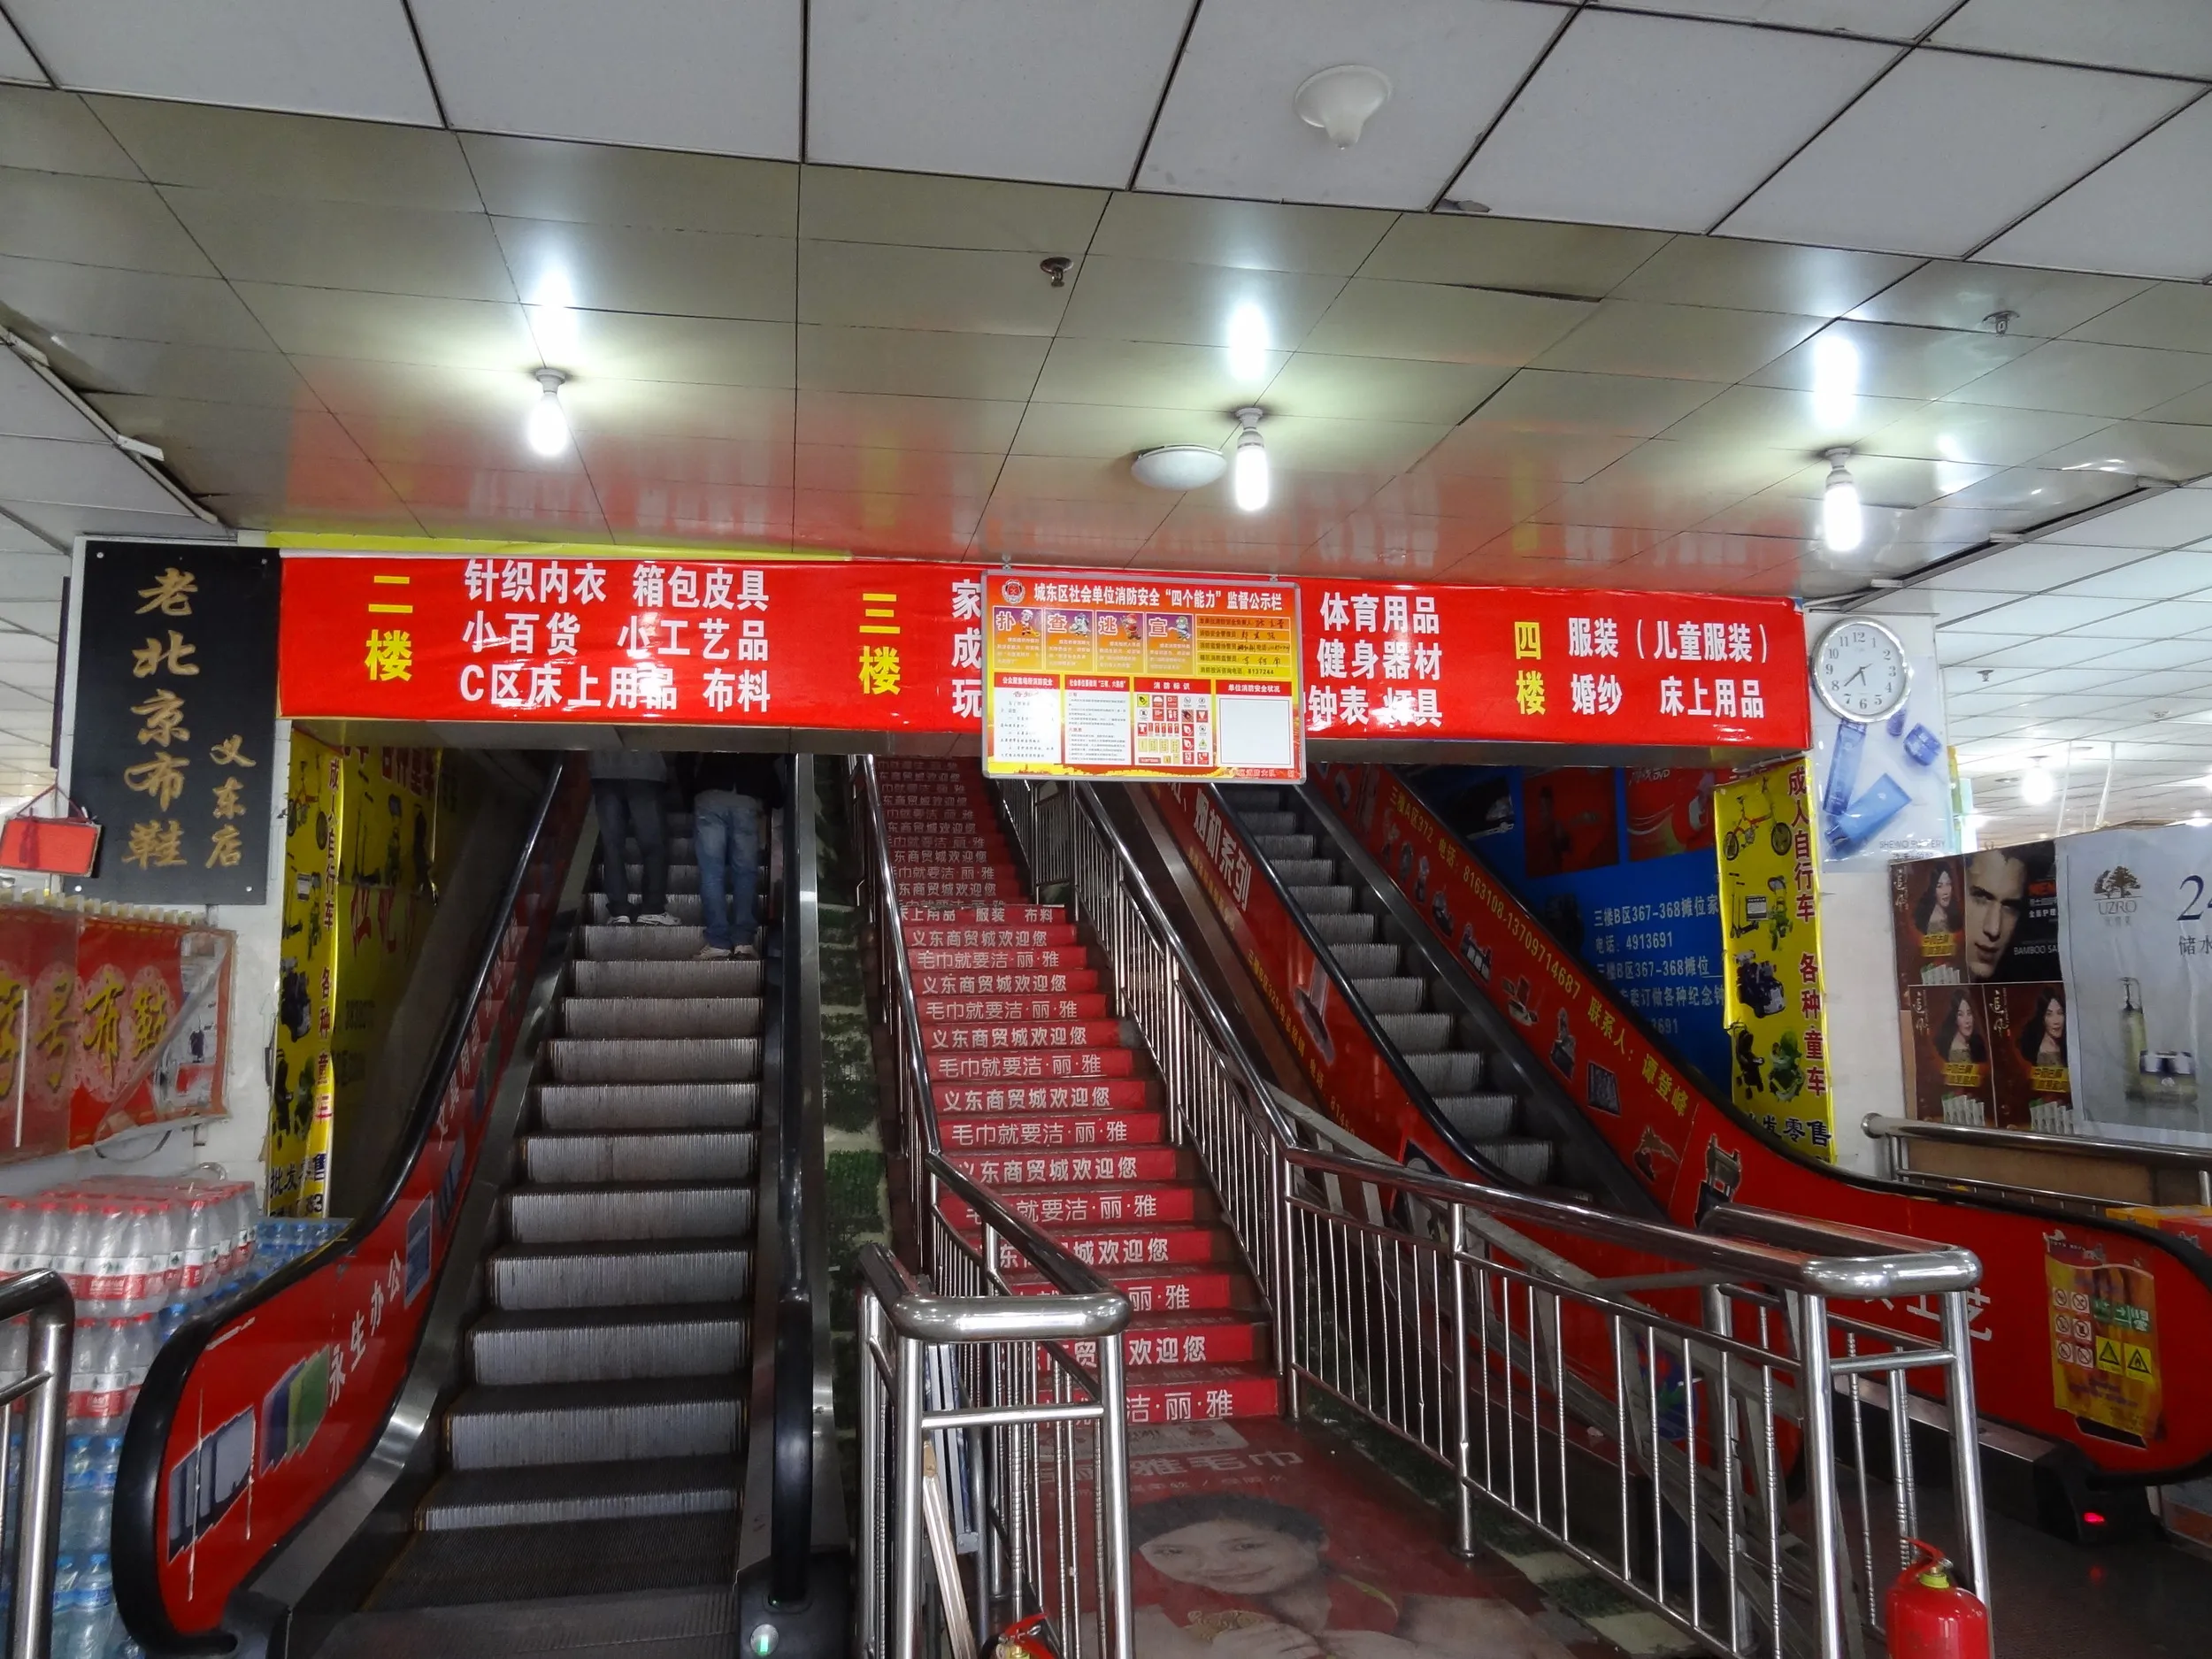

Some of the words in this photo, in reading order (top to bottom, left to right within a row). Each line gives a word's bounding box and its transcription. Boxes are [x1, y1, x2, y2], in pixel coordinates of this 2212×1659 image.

[465, 559, 607, 605] 针织内衣
[633, 564, 770, 611] 箱包皮具
[996, 611, 1017, 632] 扑
[1047, 612, 1067, 634] 查
[1319, 591, 1440, 634] 体育用品
[365, 575, 413, 682] 二楼
[1097, 615, 1118, 636] 逃
[1148, 617, 1169, 637] 宣
[462, 611, 580, 656] 小百货
[617, 615, 768, 662] 小工艺品
[859, 593, 901, 695] 三楼
[1839, 636, 1849, 647] 11
[1852, 632, 1866, 643] 12
[1871, 637, 1877, 648] 1
[1317, 637, 1442, 681] 健身器材
[1828, 648, 1839, 659] 10
[1883, 649, 1891, 660] 2
[1514, 621, 1546, 716] 四楼
[1825, 664, 1833, 675] 9
[1888, 665, 1897, 677] 3
[460, 664, 677, 710] C区床上用品
[703, 668, 771, 713] 布料
[1571, 672, 1624, 716] 婚纱
[1660, 675, 1764, 718] 床上用品
[1831, 680, 1840, 691] 8
[1885, 681, 1893, 693] 4
[1843, 693, 1852, 705] 7
[1859, 698, 1868, 710] 6
[1874, 695, 1883, 706] 5
[121, 567, 200, 868] 老北京布鞋
[205, 733, 257, 868] 义东店
[1787, 765, 1816, 923] 成人自行车
[2098, 900, 2137, 915] UZRO
[2177, 875, 2212, 921] 2
[976, 907, 1006, 924] 服装
[1025, 908, 1054, 923] 布料
[912, 930, 1048, 949] 义东商贸城欢迎您
[2013, 945, 2046, 956] BAMBOO
[922, 974, 1068, 995] 义东商贸城欢迎您
[1799, 953, 1826, 1096] 各种童车
[932, 1026, 1087, 1049] 义东商贸城欢迎您
[943, 1087, 1110, 1112] 义东商贸城欢迎您
[1748, 1112, 1832, 1148] 发零售
